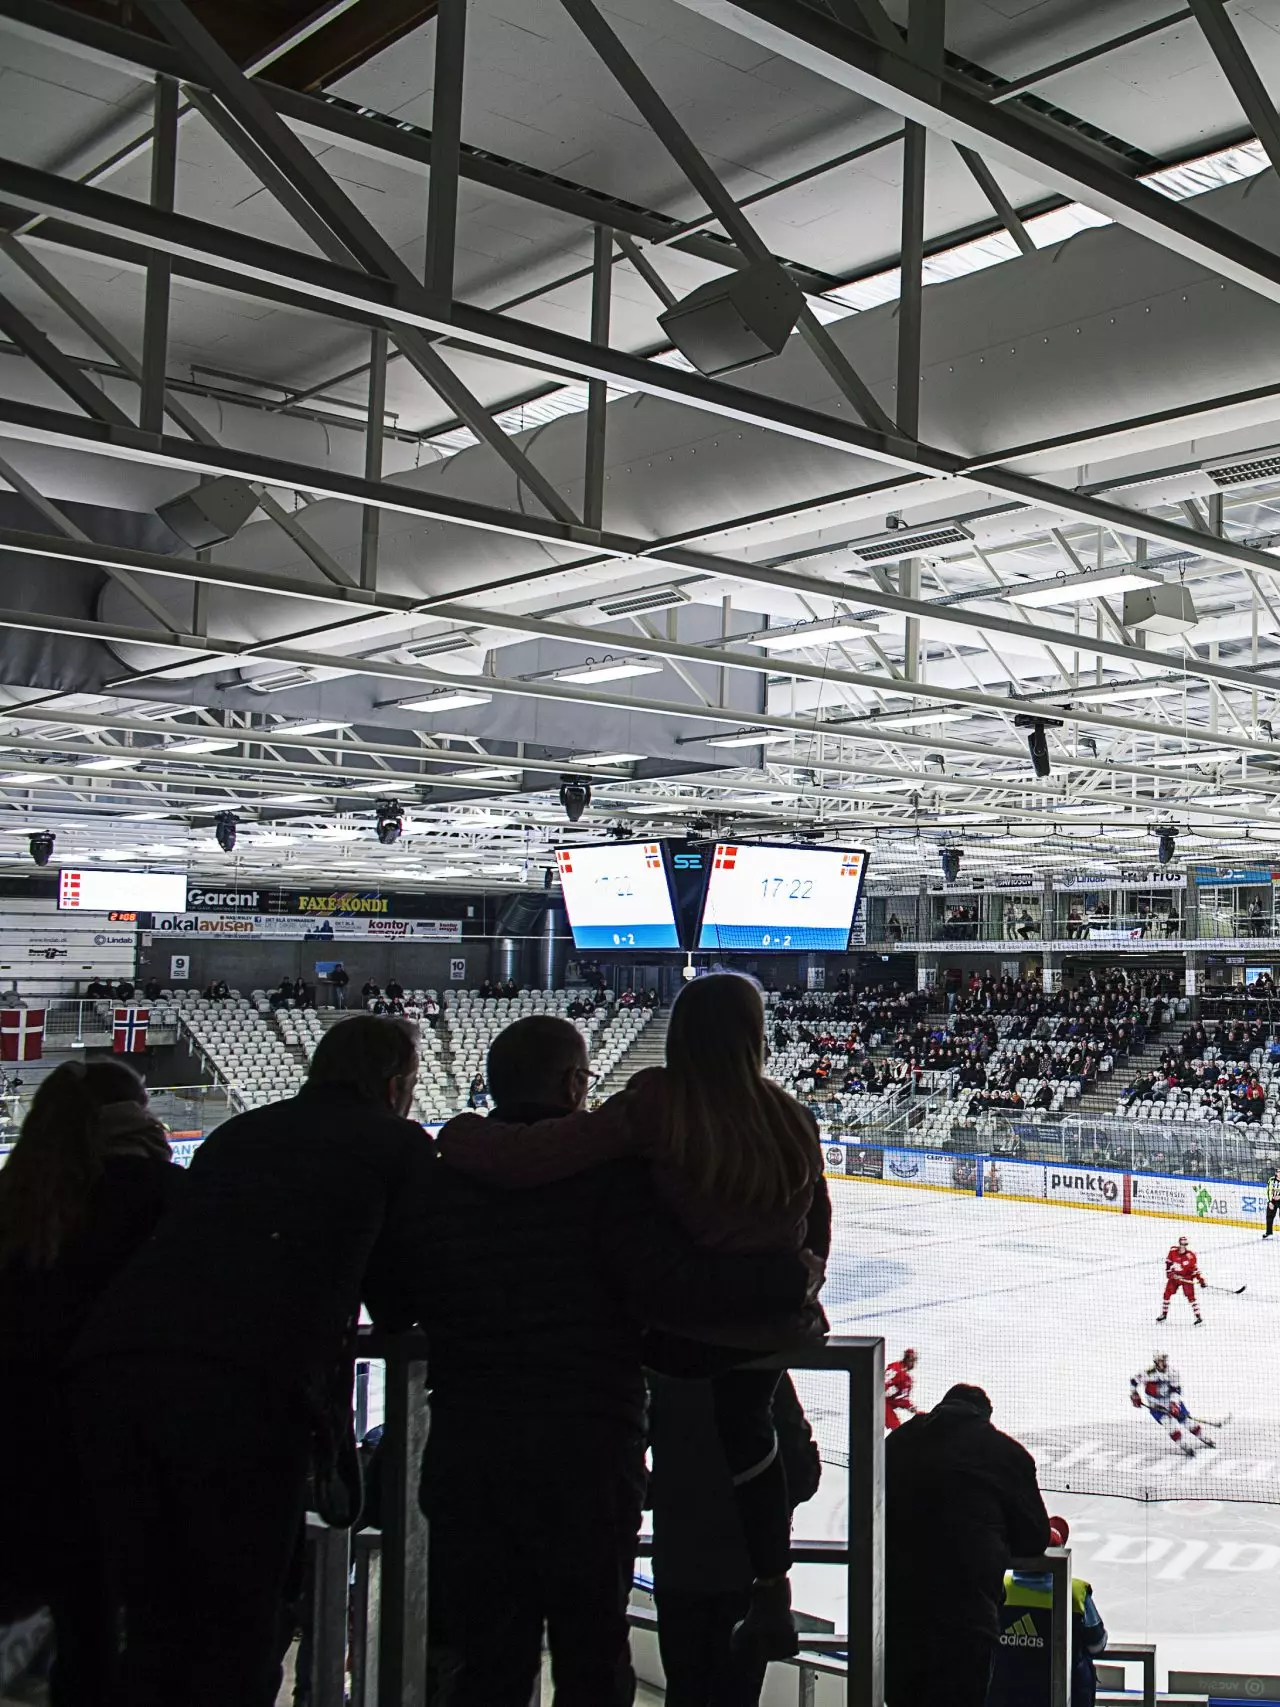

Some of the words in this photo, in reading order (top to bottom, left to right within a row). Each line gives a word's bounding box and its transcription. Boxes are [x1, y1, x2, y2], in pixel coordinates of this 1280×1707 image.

[673, 854, 703, 869] SE
[187, 889, 260, 907] Garant
[299, 896, 337, 911] FAXE
[340, 898, 389, 913] KONDI
[109, 911, 137, 922] 21:08
[151, 916, 255, 933] Lokalavisen
[368, 919, 410, 930] kontor
[106, 936, 133, 944] Lindab
[175, 957, 185, 969] 9
[452, 961, 464, 971] 10
[1050, 971, 1062, 982] 12
[1051, 1173, 1105, 1191] punkt
[1210, 1198, 1228, 1215] AB
[999, 1633, 1044, 1648] adidas
